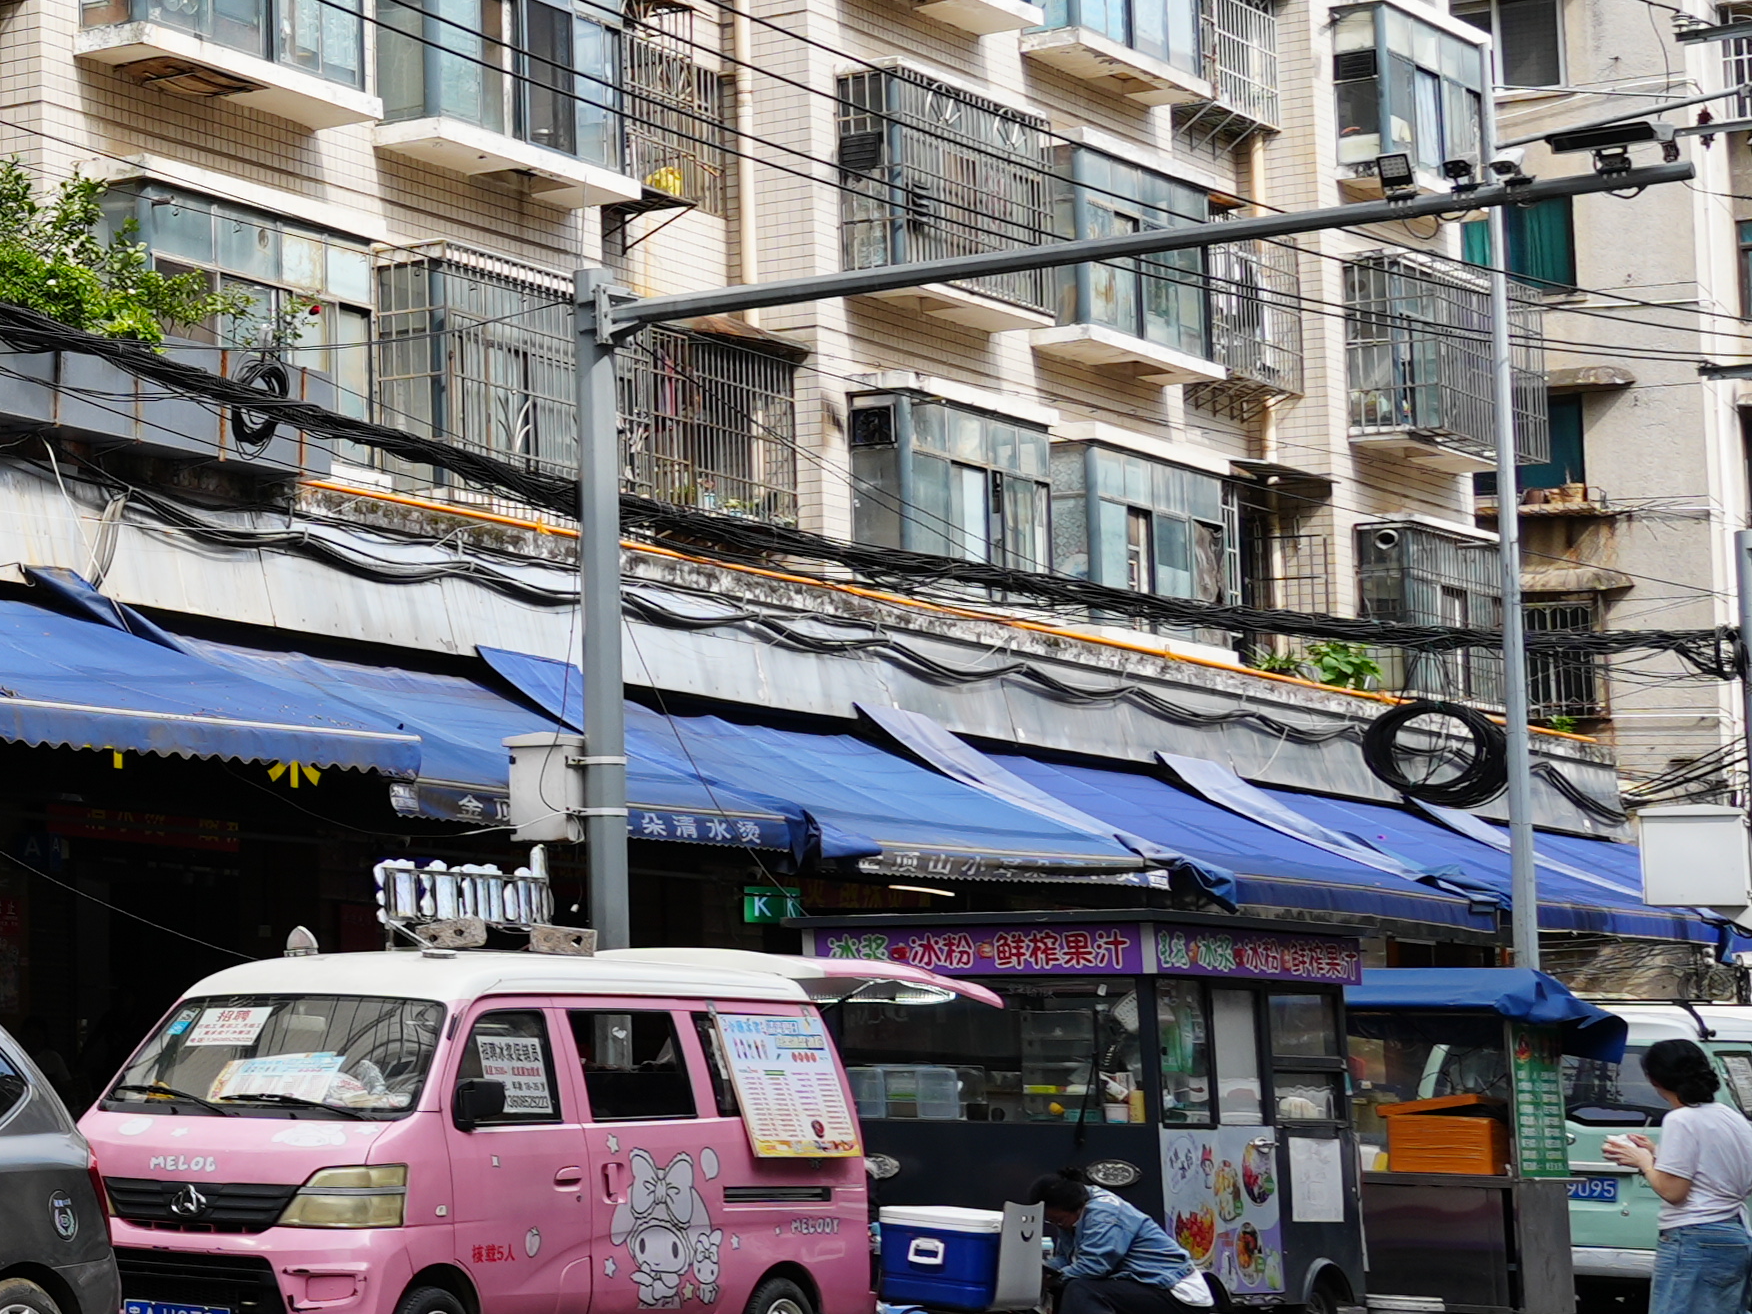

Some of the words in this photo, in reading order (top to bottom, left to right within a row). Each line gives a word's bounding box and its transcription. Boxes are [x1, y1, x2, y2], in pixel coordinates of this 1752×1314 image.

[627, 811, 759, 845] 朵清水烫
[753, 896, 773, 917] K
[908, 933, 973, 970] 冰粉
[993, 930, 1130, 970] 鲜榨果汁
[1244, 937, 1281, 974] 冰粉
[1289, 940, 1358, 981] 鲜榨果汁
[216, 1009, 252, 1023] 招聘
[790, 1217, 841, 1235] MELODY
[471, 1243, 516, 1264] 核载5人
